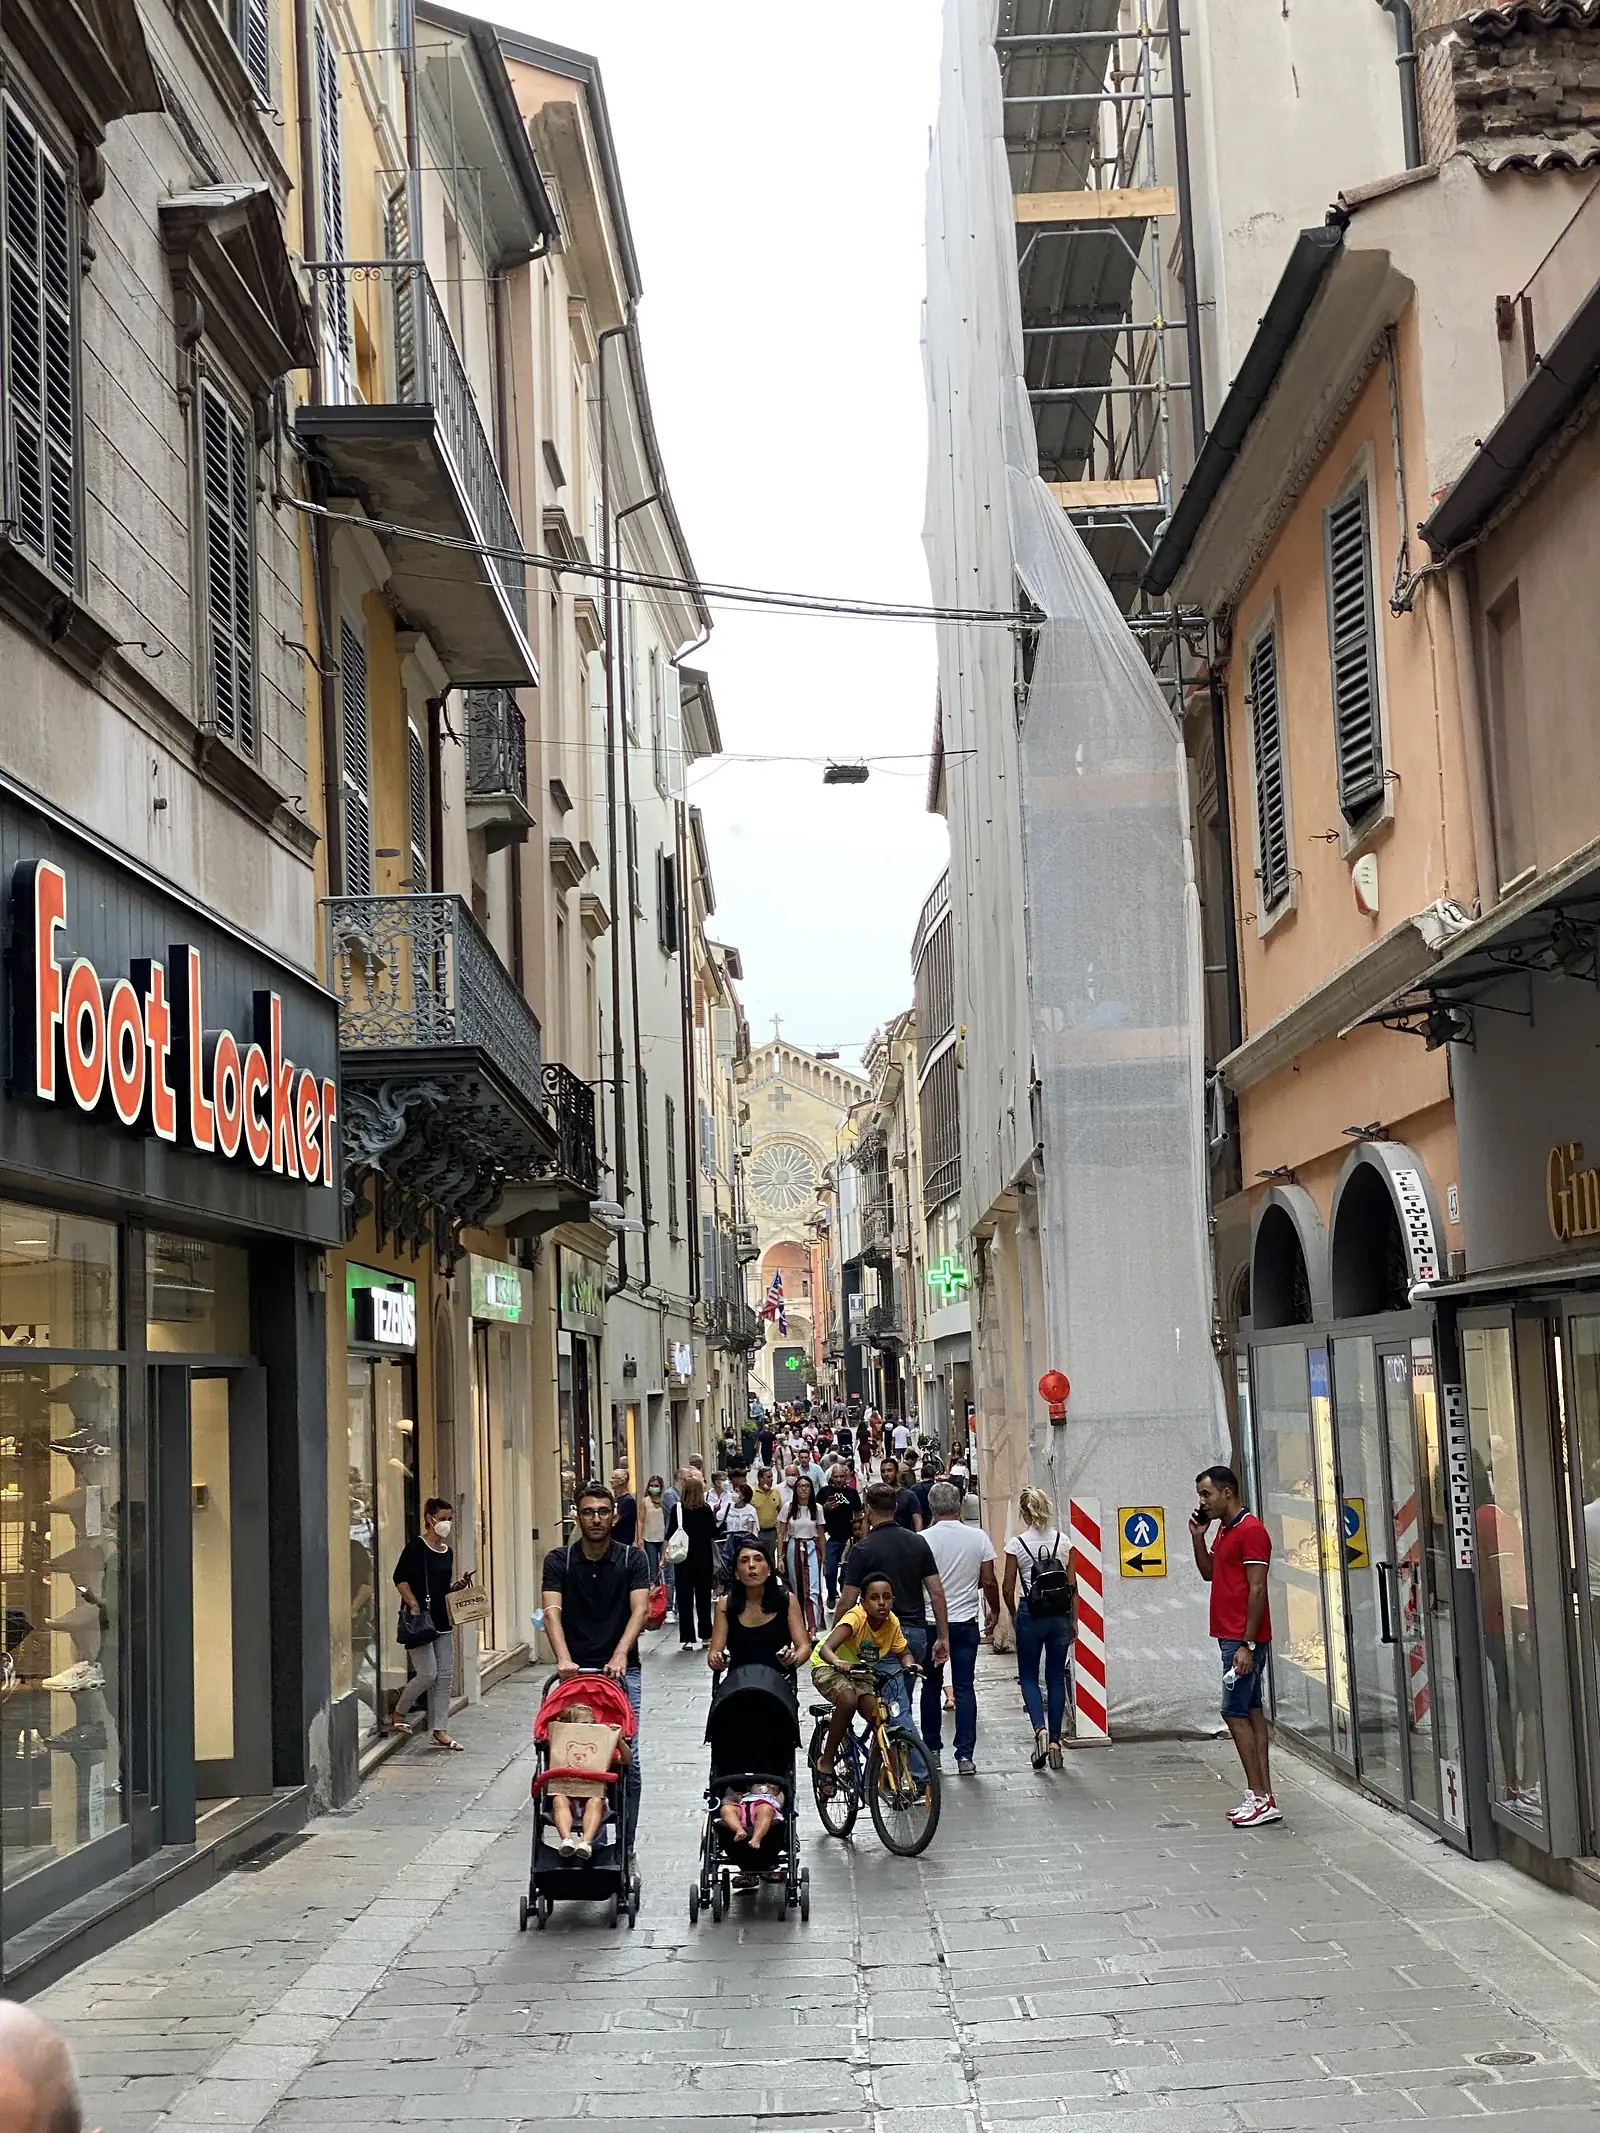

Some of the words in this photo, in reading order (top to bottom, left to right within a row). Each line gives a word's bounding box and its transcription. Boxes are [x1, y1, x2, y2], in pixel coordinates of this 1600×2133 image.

[34, 858, 177, 1143] Foot
[187, 943, 338, 1189] Locker
[1403, 1195, 1434, 1263] CINTURINI
[1446, 1387, 1465, 1428] PILE
[1451, 1435, 1466, 1445] E
[1451, 1452, 1473, 1547] CINTURINI
[455, 1596, 485, 1609] TEZENIS
